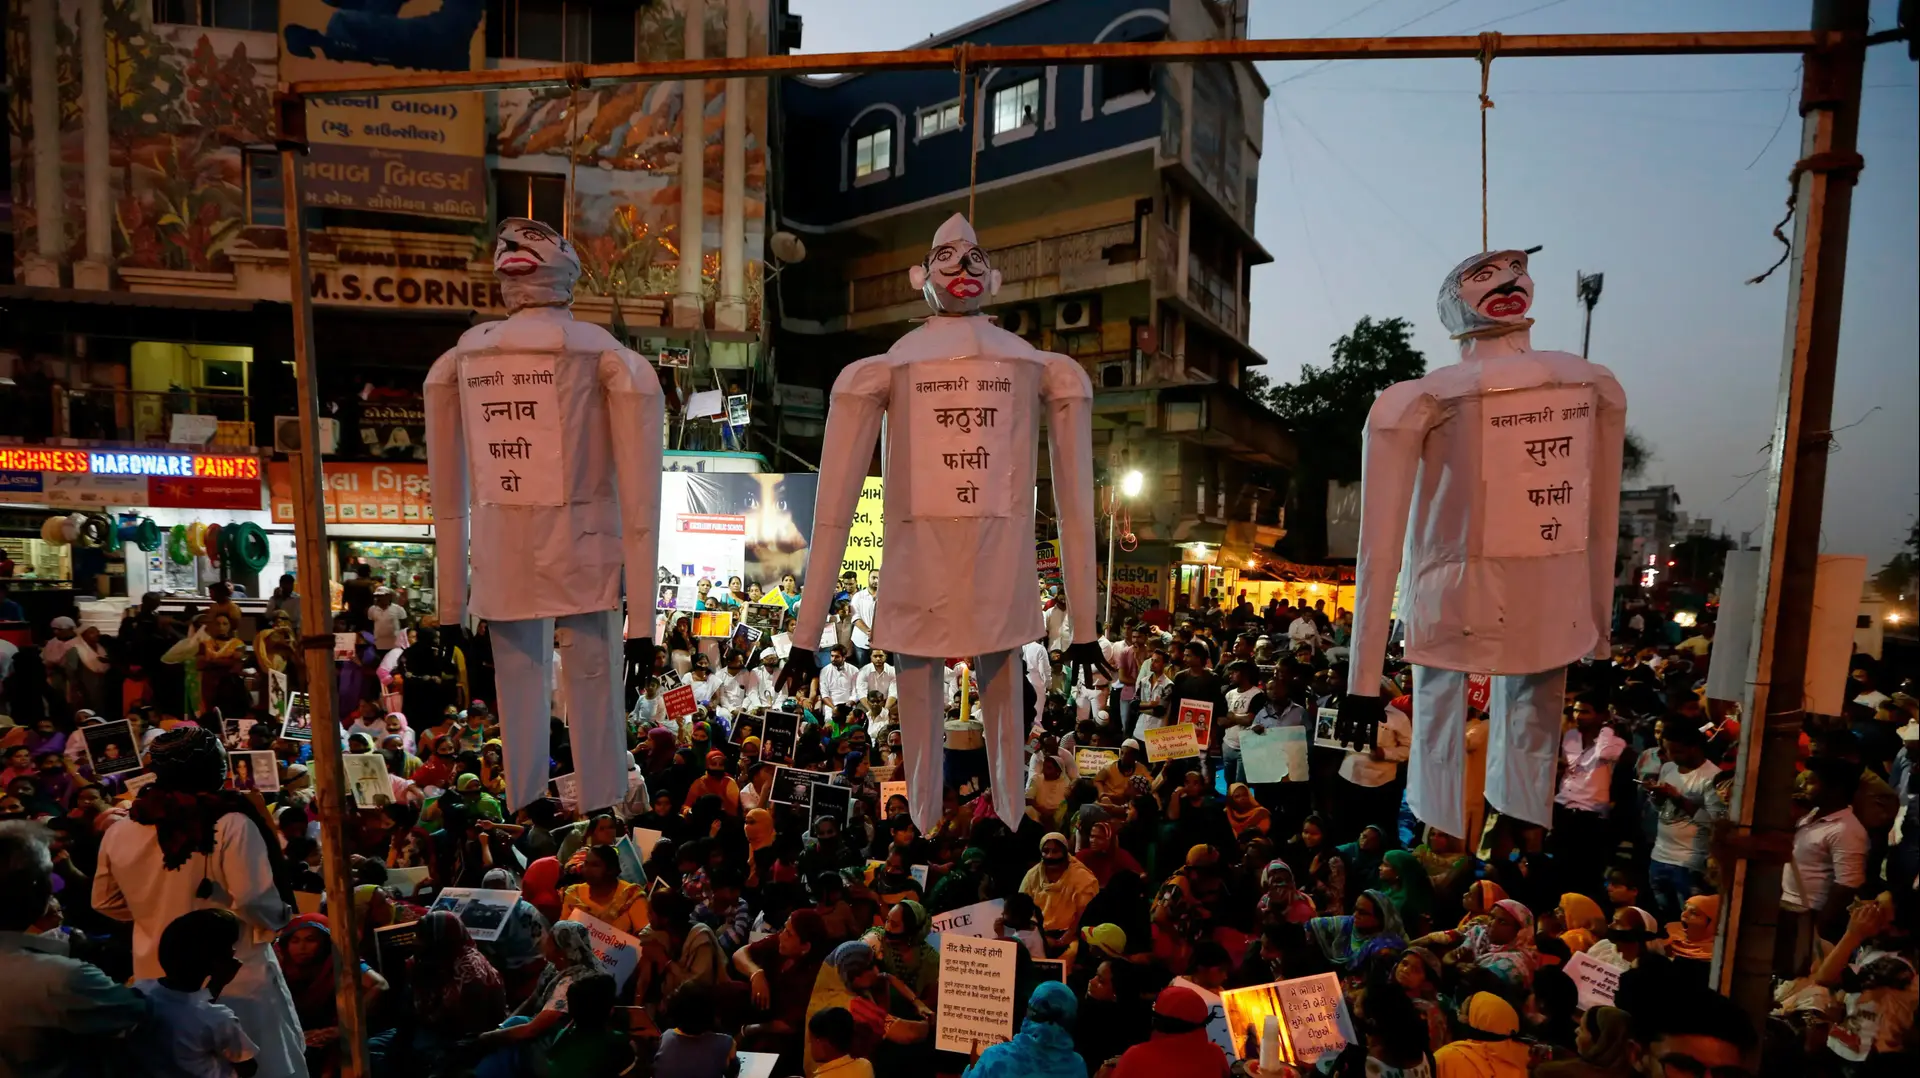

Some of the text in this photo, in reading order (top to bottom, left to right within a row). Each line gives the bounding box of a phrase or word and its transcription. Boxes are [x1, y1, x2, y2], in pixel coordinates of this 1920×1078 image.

[481, 401, 538, 423] उन्नाव
[933, 407, 998, 434] कठुआ
[488, 436, 532, 460] फांसी
[942, 445, 990, 470] फांसी
[1524, 436, 1573, 467] सुरत
[0, 450, 259, 479] HIGHNESS HARDWARE PAINTS
[500, 469, 522, 492] दो
[956, 480, 980, 503] दो
[1527, 480, 1573, 507] फांसी
[1540, 517, 1562, 541] दो
[1037, 549, 1055, 560] EROX
[932, 913, 972, 934] STICE
[959, 943, 972, 954] कैसे
[973, 946, 987, 957] आई
[988, 948, 1003, 958] होगी
